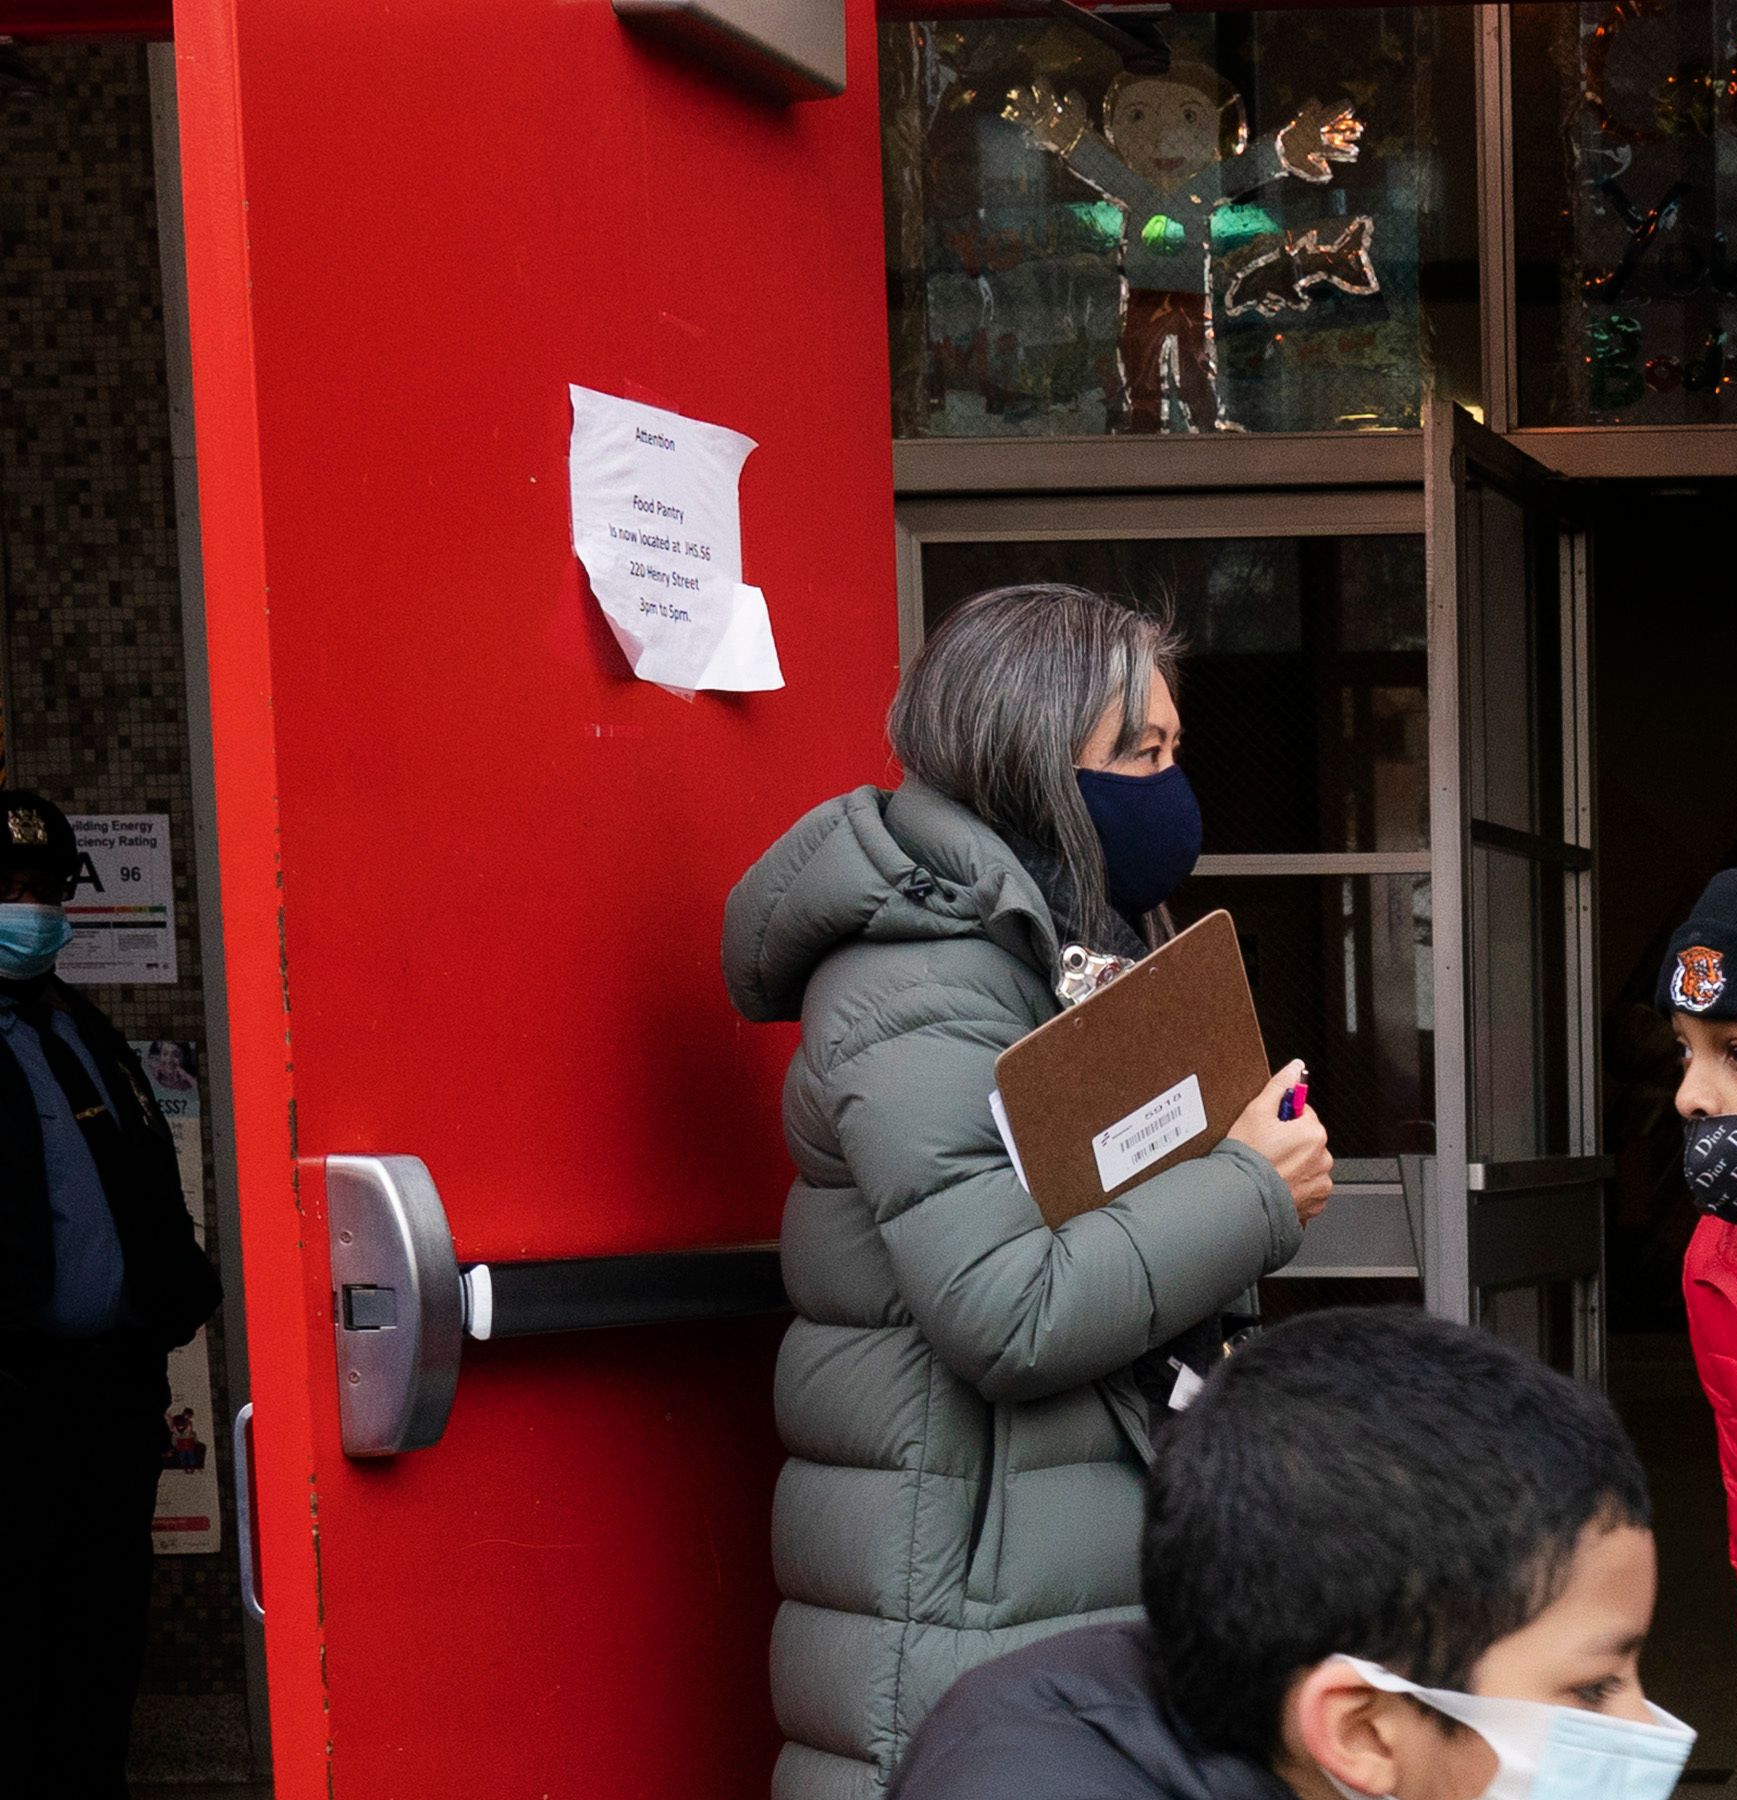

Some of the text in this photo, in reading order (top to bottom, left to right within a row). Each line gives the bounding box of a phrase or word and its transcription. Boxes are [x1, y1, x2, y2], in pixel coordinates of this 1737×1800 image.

[635, 427, 675, 451] Attention
[633, 495, 684, 525] Food Pantry
[618, 528, 638, 543] now
[639, 529, 670, 551] located
[672, 539, 682, 554] at
[630, 561, 700, 591] 220 Henry Street
[639, 597, 658, 617] 3pm
[659, 602, 668, 618] to
[72, 820, 154, 834] ilding Energy
[77, 836, 158, 849] ciency Rating
[74, 852, 141, 893] A 96
[158, 1100, 188, 1114] ESS?
[1694, 1124, 1727, 1158] Dior
[1695, 1158, 1728, 1188] Dior
